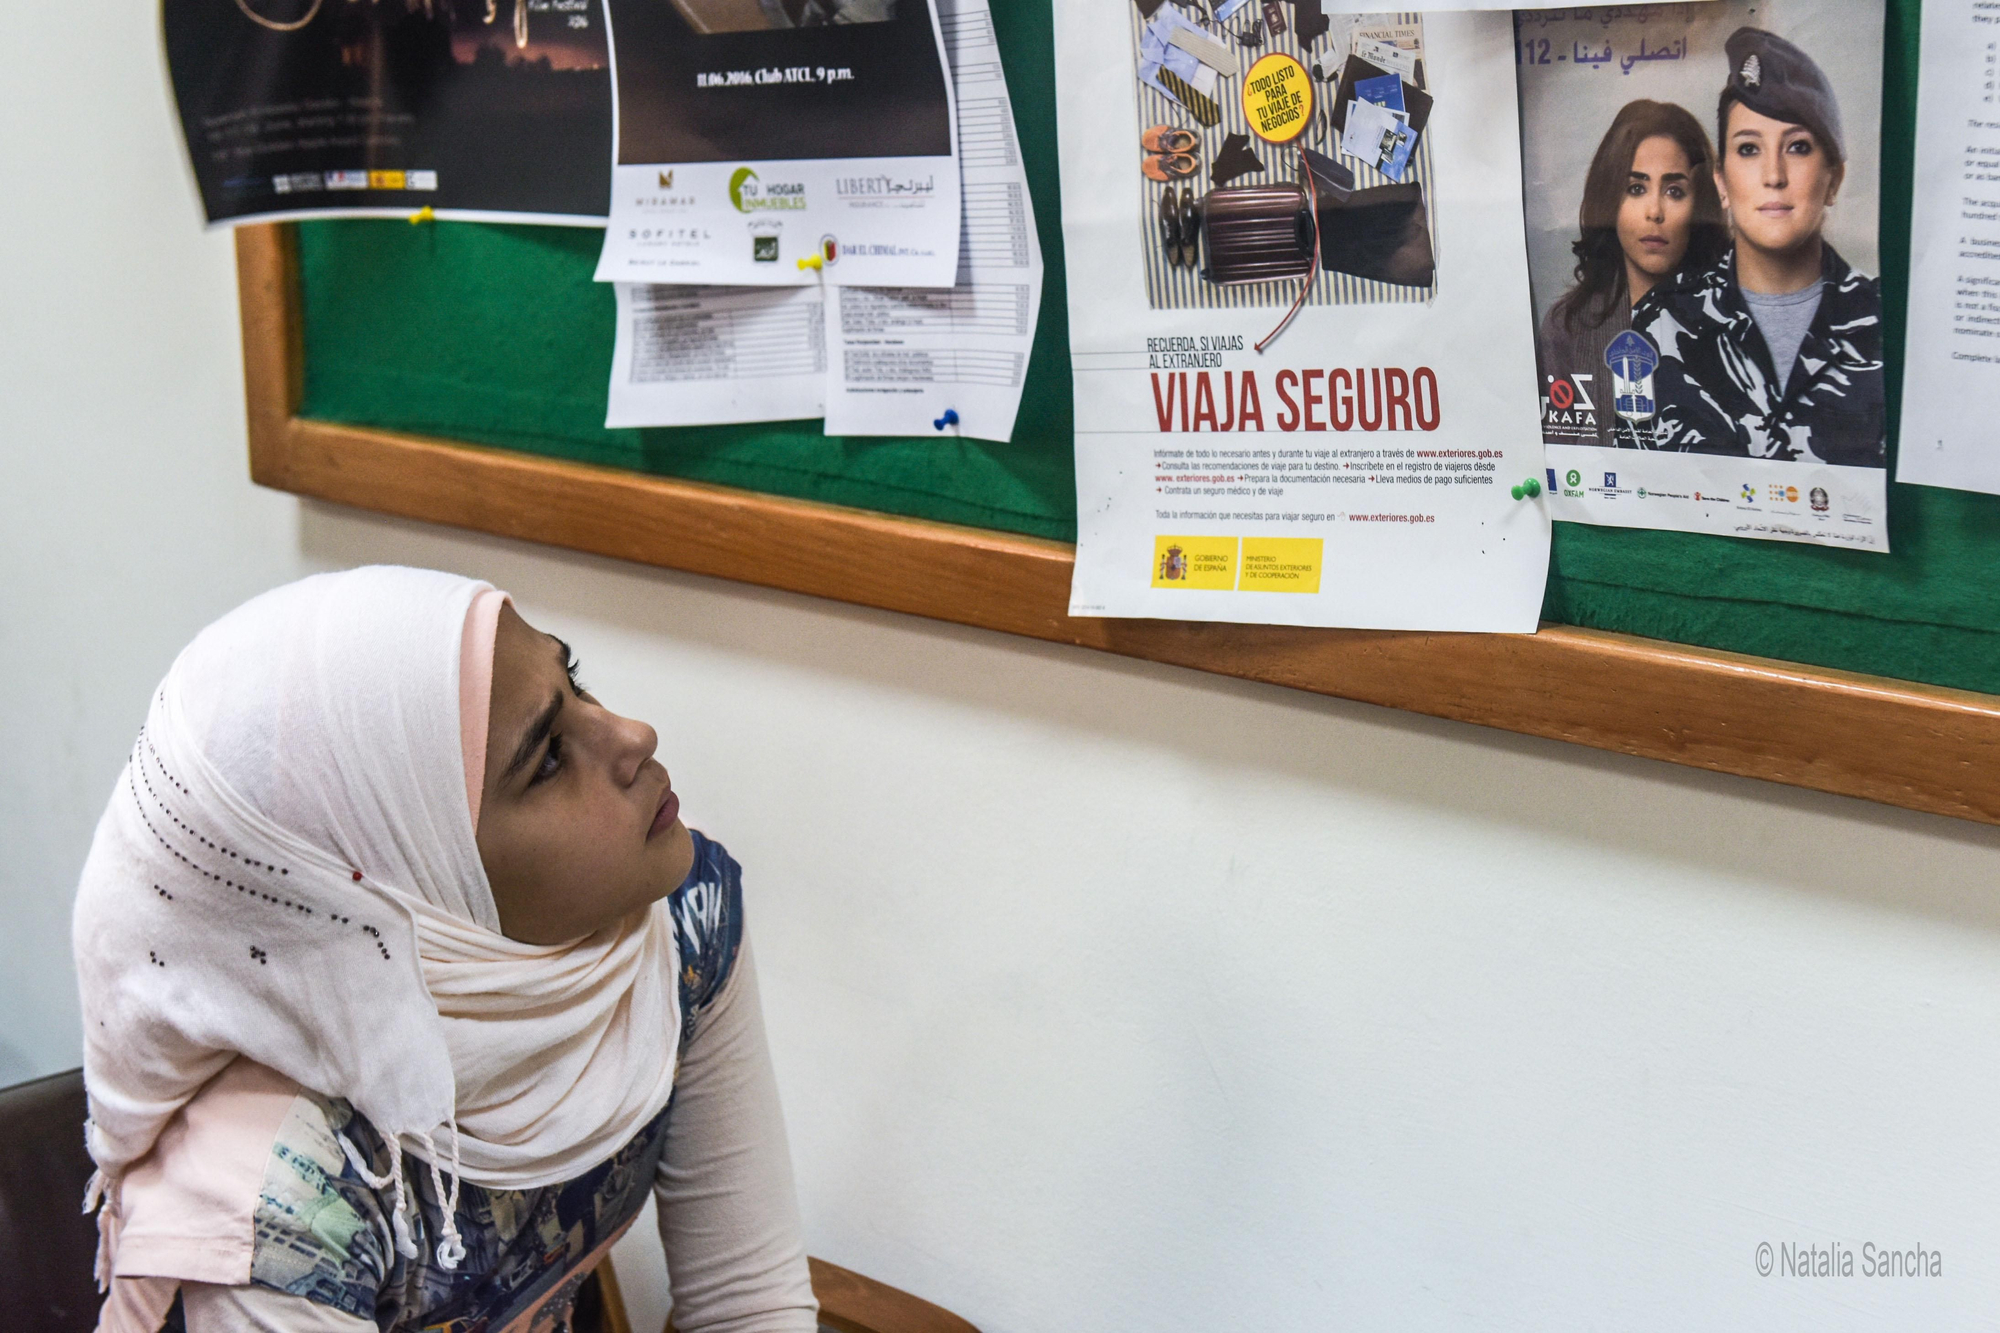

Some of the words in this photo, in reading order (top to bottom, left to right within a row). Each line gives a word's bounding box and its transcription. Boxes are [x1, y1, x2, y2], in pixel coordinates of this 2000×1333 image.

[1360, 31, 1393, 39] FINANCIAL
[1395, 29, 1415, 38] TIMES
[1368, 51, 1386, 64] Monde
[1574, 40, 1612, 69] فينا
[1620, 36, 1687, 75] اتصلي
[755, 67, 782, 84] Club
[816, 67, 825, 81] 9
[827, 68, 855, 84] p.m.
[1272, 65, 1295, 85] LISTO
[1265, 83, 1288, 102] PARA
[1256, 105, 1268, 120] TU
[1268, 96, 1291, 116] VIAJE
[1290, 90, 1303, 106] DE
[1261, 104, 1305, 133] NEGOCIOS?
[766, 183, 805, 196] HOGAR
[744, 197, 806, 209] INMUEBLES
[628, 228, 711, 240] SOFITEL
[1147, 336, 1199, 353] RECUERDA,
[1200, 335, 1210, 351] SI
[1211, 334, 1244, 351] VIAJAS
[1149, 354, 1161, 369] AL
[1163, 352, 1222, 369] EXTRANJERO
[1150, 370, 1265, 433] VIAJA
[1275, 366, 1441, 432] SEGURO
[1549, 410, 1597, 425] KAFA
[1154, 449, 1184, 458] Infórmate
[1186, 450, 1194, 458] de
[1196, 450, 1210, 458] todo
[1212, 450, 1217, 458] lo
[1219, 450, 1250, 458] necesario
[1278, 449, 1304, 458] durante
[1314, 450, 1330, 459] viaje
[1332, 449, 1338, 458] al
[1340, 449, 1374, 459] extranjero
[1383, 449, 1404, 458] través
[1406, 449, 1414, 458] de
[1417, 449, 1503, 459] www.exteriores.gob.es
[1162, 462, 1189, 470] Consulta
[1191, 462, 1200, 470] las
[1202, 462, 1259, 470] recomendaciones
[1261, 462, 1269, 470] de
[1271, 462, 1286, 471] viaje
[1314, 462, 1340, 470] destino.
[1351, 462, 1384, 471] Inscríbete
[1397, 462, 1403, 471] el
[1405, 462, 1432, 472] registro
[1434, 462, 1442, 471] de
[1445, 462, 1472, 472] viajeros
[1176, 475, 1234, 483] exteriores.gob.es
[1245, 475, 1270, 484] Prepara
[1272, 475, 1278, 483] la
[1280, 474, 1330, 483] documentación
[1333, 475, 1365, 483] necesaria
[1376, 475, 1394, 483] Lleva
[1396, 475, 1421, 483] medios
[1424, 475, 1432, 484] de
[1435, 477, 1452, 485] pago
[1454, 475, 1493, 484] suficientes
[1165, 486, 1191, 494] Contrata
[1203, 488, 1225, 496] seguro
[1227, 487, 1250, 495] médico
[1258, 487, 1266, 495] de
[1268, 487, 1283, 496] viaje
[1563, 489, 1584, 498] OXFAM
[1156, 510, 1170, 519] Toda
[1172, 510, 1177, 519] la
[1180, 510, 1217, 519] información
[1219, 512, 1231, 521] que
[1233, 511, 1263, 520] necesitas
[1265, 513, 1280, 521] para
[1282, 511, 1299, 522] viajar
[1302, 513, 1324, 522] seguro
[1349, 513, 1435, 524] www.exteriores.gob.es
[1204, 563, 1227, 572] ESPAÑA
[1258, 571, 1299, 579] COOPERACIÓN
